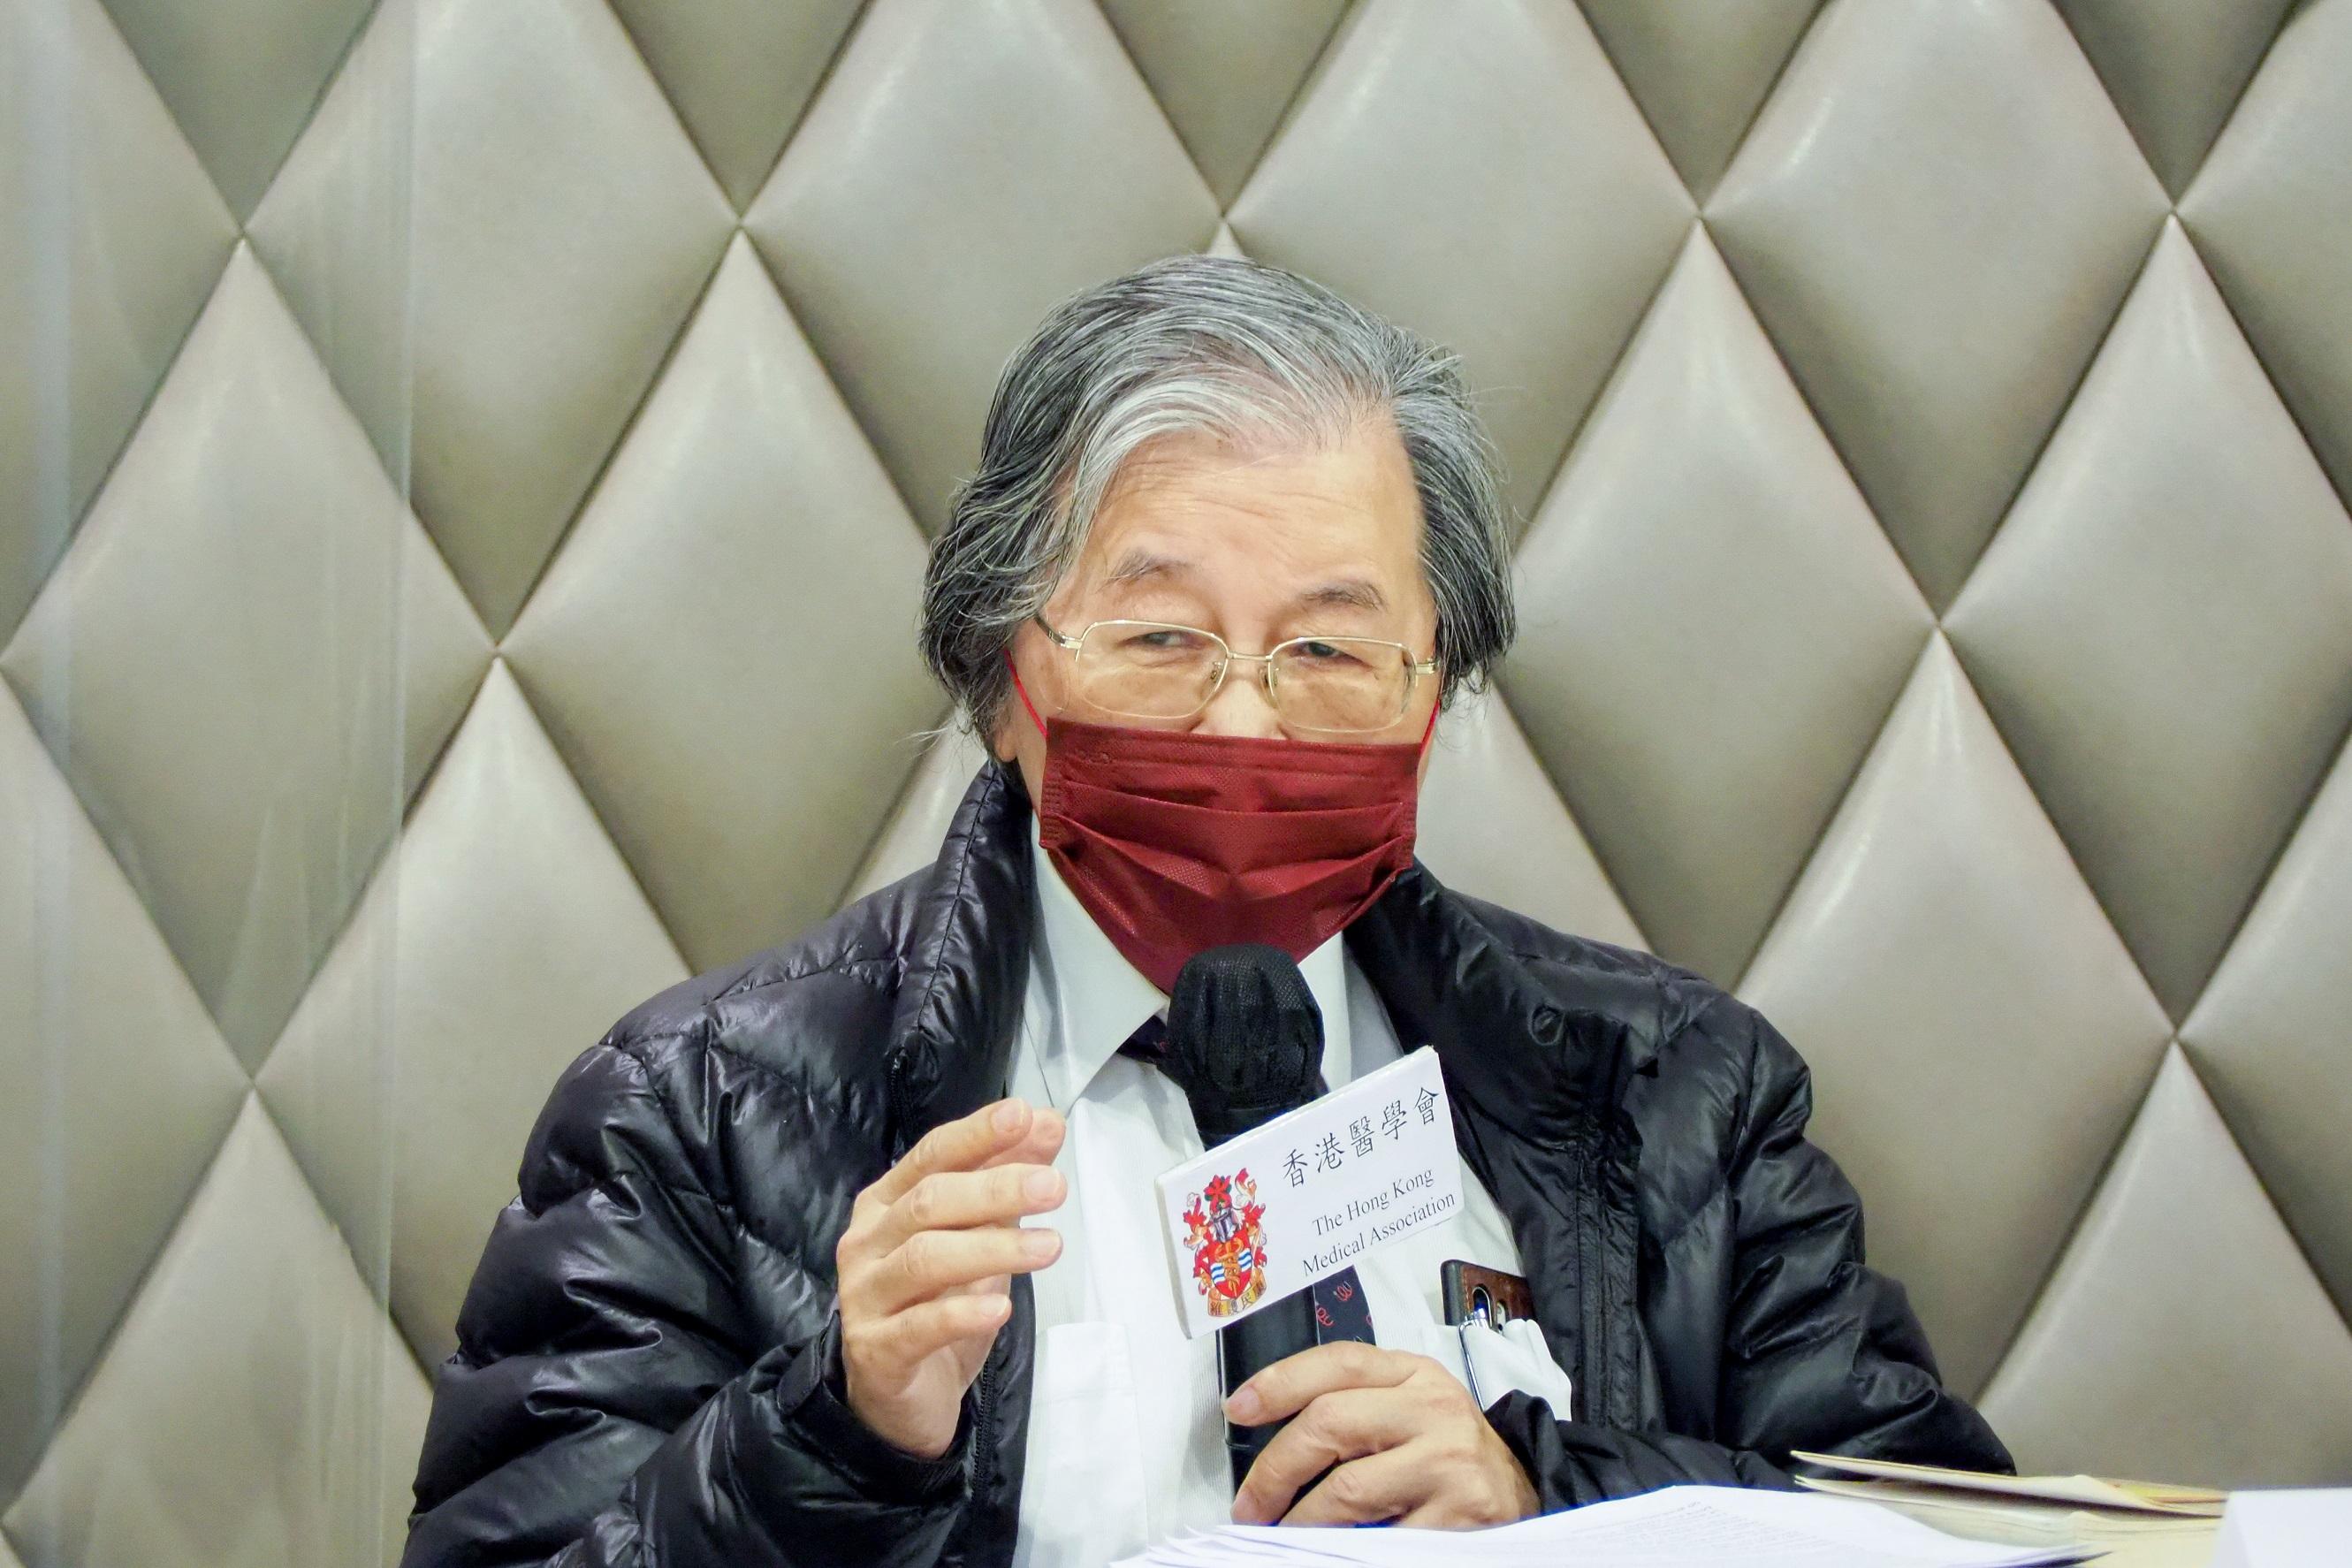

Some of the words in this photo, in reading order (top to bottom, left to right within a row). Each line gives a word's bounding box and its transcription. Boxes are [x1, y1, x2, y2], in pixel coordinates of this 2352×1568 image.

[1283, 1087, 1439, 1187] 香港醫學會
[1302, 1233, 1366, 1277] Medical
[1370, 1193, 1455, 1245] Association
[1312, 1214, 1343, 1237] The
[1346, 1191, 1389, 1222] Hong
[1393, 1168, 1434, 1199] Kong
